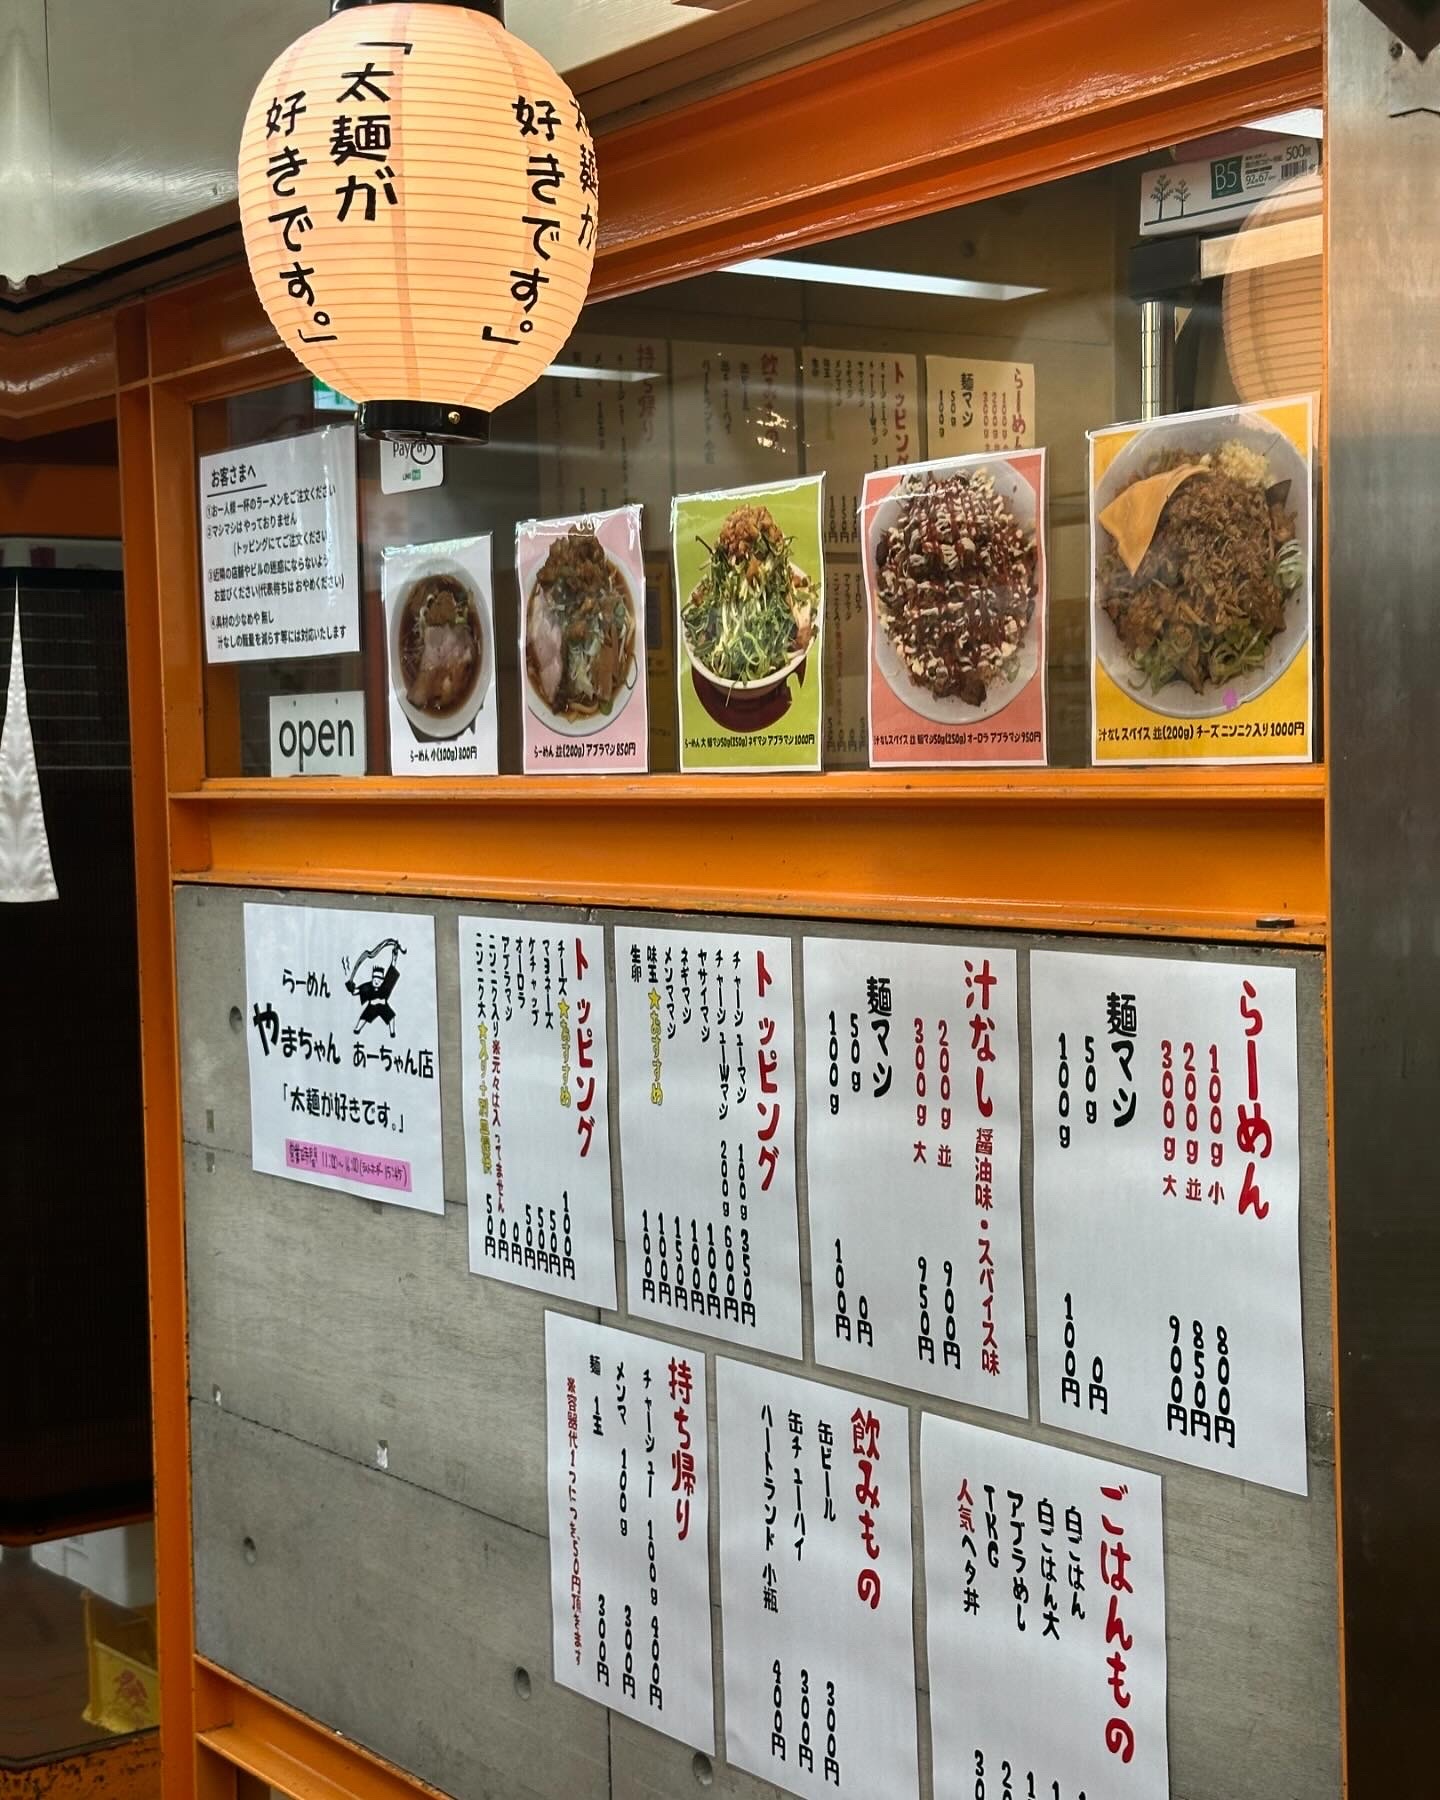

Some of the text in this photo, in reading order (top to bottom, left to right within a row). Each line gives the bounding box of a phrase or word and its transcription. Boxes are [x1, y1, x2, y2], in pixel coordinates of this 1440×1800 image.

[265, 41, 413, 345] 「太麺が 好きです。」
[481, 96, 566, 346] 好きです。」
[1214, 161, 1239, 191] B5
[211, 464, 257, 488] お客さまへ
[279, 719, 354, 773] open
[252, 1002, 435, 1079] やまちゃん あーちゃん店
[282, 968, 331, 998] らーめん
[283, 1082, 404, 1134] 「太麺が好きです。」
[476, 932, 486, 1019] ニンニク大
[485, 1193, 496, 1259] 50円
[489, 934, 500, 1038] ニンニク入り
[498, 1218, 509, 1263] 0円
[502, 936, 522, 1266] アブラマシ 0円
[516, 936, 536, 1270] オーロラ 50円
[529, 937, 549, 1274] ケチャップ 50円
[542, 939, 561, 1278] マヨネーズ 50円
[557, 940, 567, 996] チーズ
[563, 1190, 575, 1281] 100円
[576, 938, 596, 1158] トッピング
[630, 944, 655, 1304] 生卵 100円
[647, 945, 658, 984] 味玉
[658, 1212, 671, 1307] 100円
[664, 947, 688, 1311] メンママシ 150円
[680, 947, 705, 1315] ネギマシ 100円
[698, 949, 721, 1319] ヤサイマシ 100円
[715, 949, 739, 1322] チャーシューWマシ 200g 600円
[732, 951, 756, 1328] チャーシューマシ 100g 350円
[757, 950, 780, 1191] トッピング
[866, 976, 892, 1098] 麺マシ
[964, 959, 998, 1118] 汁なし
[1106, 991, 1137, 1127] 麺マシ
[1236, 979, 1272, 1220] らーめん
[828, 1010, 851, 1342] 100g 100円
[850, 1013, 873, 1348] 50g 0円
[913, 1017, 934, 1364] 300g 大 950円
[937, 1019, 961, 1370] 200g 並 900円
[1058, 1032, 1080, 1408] 100g 100円
[1085, 1035, 1108, 1415] 50g 0円
[1161, 1039, 1187, 1436] 300g 大 900円
[1183, 1041, 1211, 1442] 200g 並 850円
[1208, 1044, 1235, 1449] 100g 小 800円
[589, 1354, 600, 1375] 麺
[597, 1593, 609, 1687] 300円
[616, 1361, 636, 1699] メンマ 100g 300円
[643, 1368, 663, 1711] チャーシュー 100g 400円
[668, 1356, 696, 1540] 持ち帰り
[761, 1404, 786, 1761] ハートランド 小瓶 400円
[788, 1409, 813, 1773] 缶チューハイ 300円
[818, 1420, 839, 1787] 缶ビール 300円
[850, 1407, 881, 1610] 飲みもの
[983, 1484, 999, 1568] TKG
[1007, 1490, 1029, 1632] アブラめし
[1037, 1498, 1060, 1640] 白ごはん大
[1065, 1505, 1085, 1620] 白ごはん
[1100, 1485, 1134, 1764] ごはんもの
